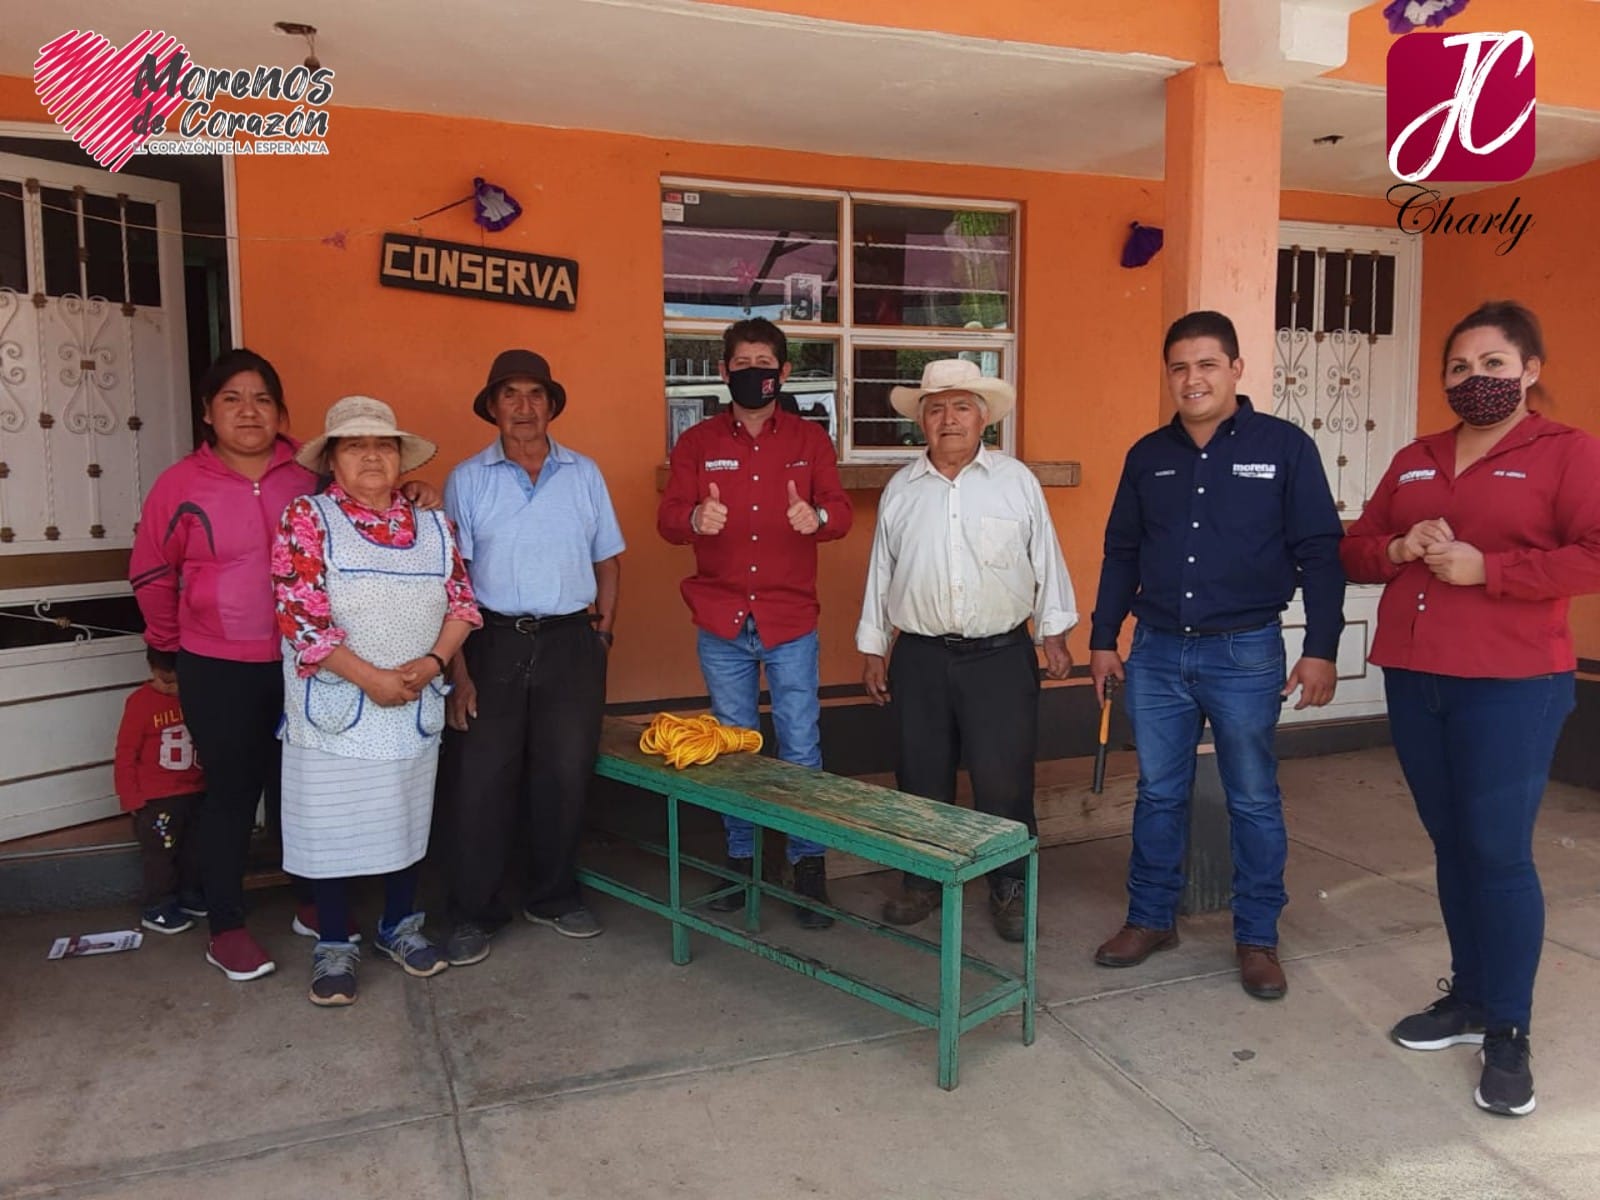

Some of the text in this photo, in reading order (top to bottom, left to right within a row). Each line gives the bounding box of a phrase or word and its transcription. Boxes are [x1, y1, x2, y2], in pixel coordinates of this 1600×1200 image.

[383, 242, 576, 304] CONSERVA
[1232, 463, 1277, 473] morena
[159, 724, 204, 770] 8
